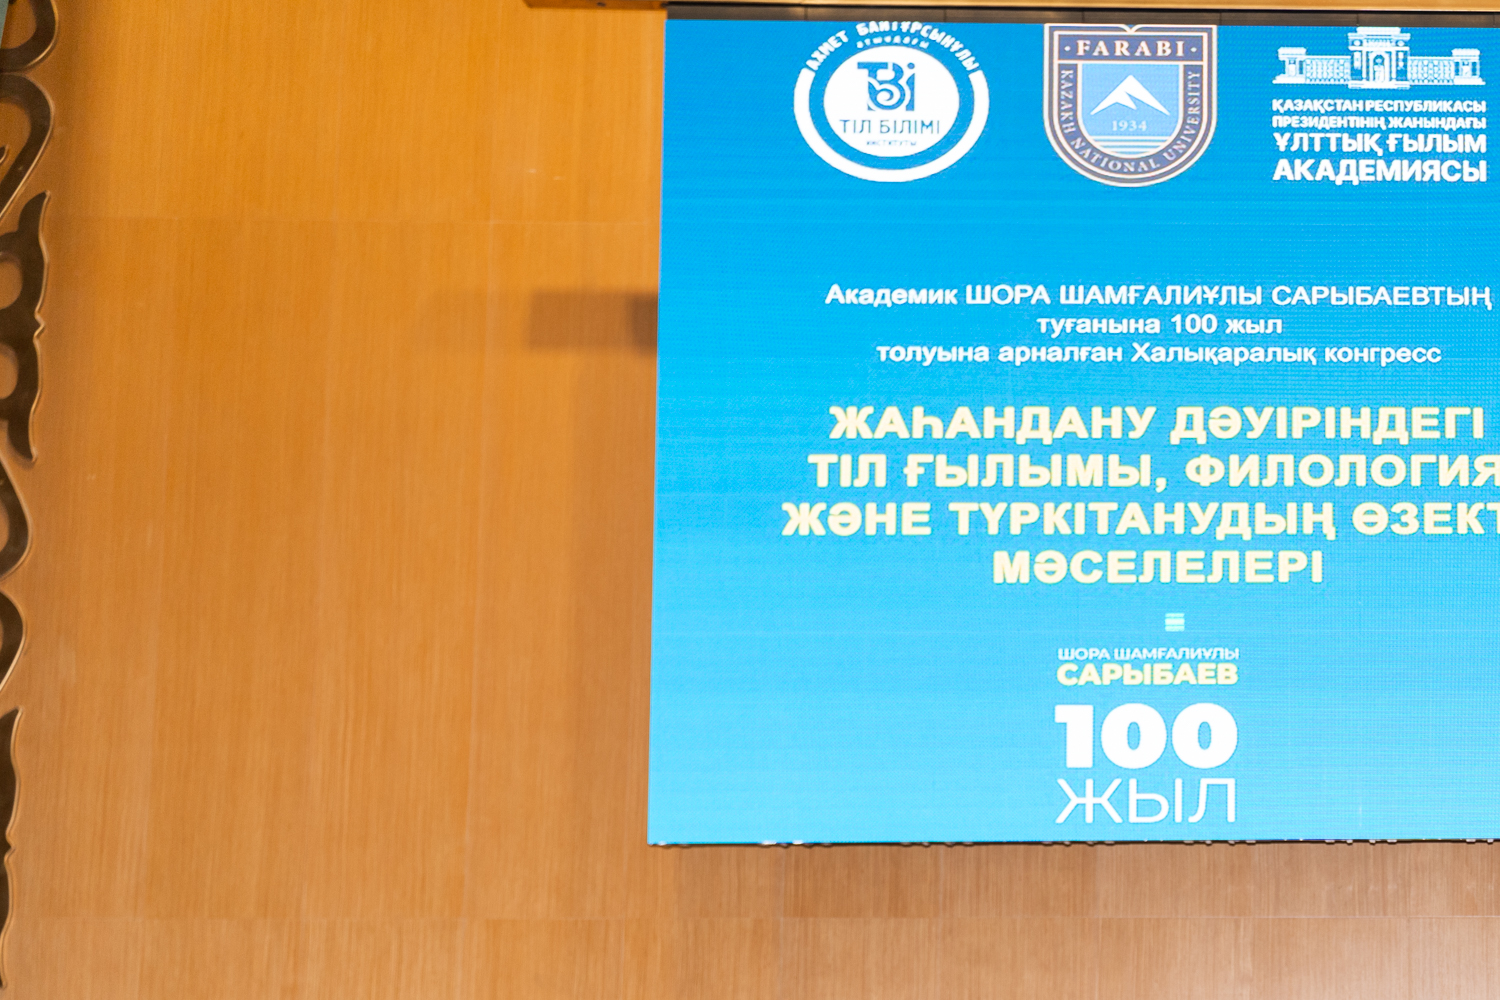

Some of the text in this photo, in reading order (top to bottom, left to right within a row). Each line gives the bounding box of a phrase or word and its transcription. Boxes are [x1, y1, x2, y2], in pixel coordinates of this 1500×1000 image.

[806, 30, 849, 71] АХМЕТ
[1076, 39, 1185, 57] FARABI
[1272, 99, 1487, 113] ҚАЗАҚСТАН РЕСПУБЛИКАСЫ
[839, 119, 940, 134] ТІЛ БІЛІМІ
[1060, 69, 1201, 173] KAZAKH NATIONAL UNIVERSITY
[1111, 119, 1148, 132] 1934
[1272, 115, 1487, 131] ПРЕЗИДЕНТІНІҢ ЖАНЫНДАҒЫ
[1272, 132, 1487, 157] ҰЛТТЫҚ ҒЫЛЫМ
[1272, 158, 1487, 186] АКАДЕМИЯСЫ
[825, 284, 1493, 311] Академик ШОРА ШАМҒАЛИҰЛЫ САРЫБАЕВТЫҢ
[1037, 315, 1283, 337] туғанына 100 жыл
[876, 342, 1442, 367] толуына арналған Халықаралық конгресс
[829, 405, 1486, 447] ЖАҺАНДАНУ ДӘУІРІНДЕГІ
[808, 453, 888, 488] ТІЛ
[902, 453, 1168, 494] ҒЫЛЫМЫ,
[781, 502, 932, 536] ЖӘНЕ
[949, 501, 1336, 543] ТҮРКІТАНУДЫҢ
[992, 549, 1325, 585] МӘСЕЛЕЛЕРІ
[1057, 646, 1240, 660] ШОРА ШАМҒАЛИҰЛЫ
[1056, 662, 1240, 686] САРЫБАЕВ
[1054, 702, 1238, 769] 100
[1054, 777, 1237, 823] ЖЫЛ
